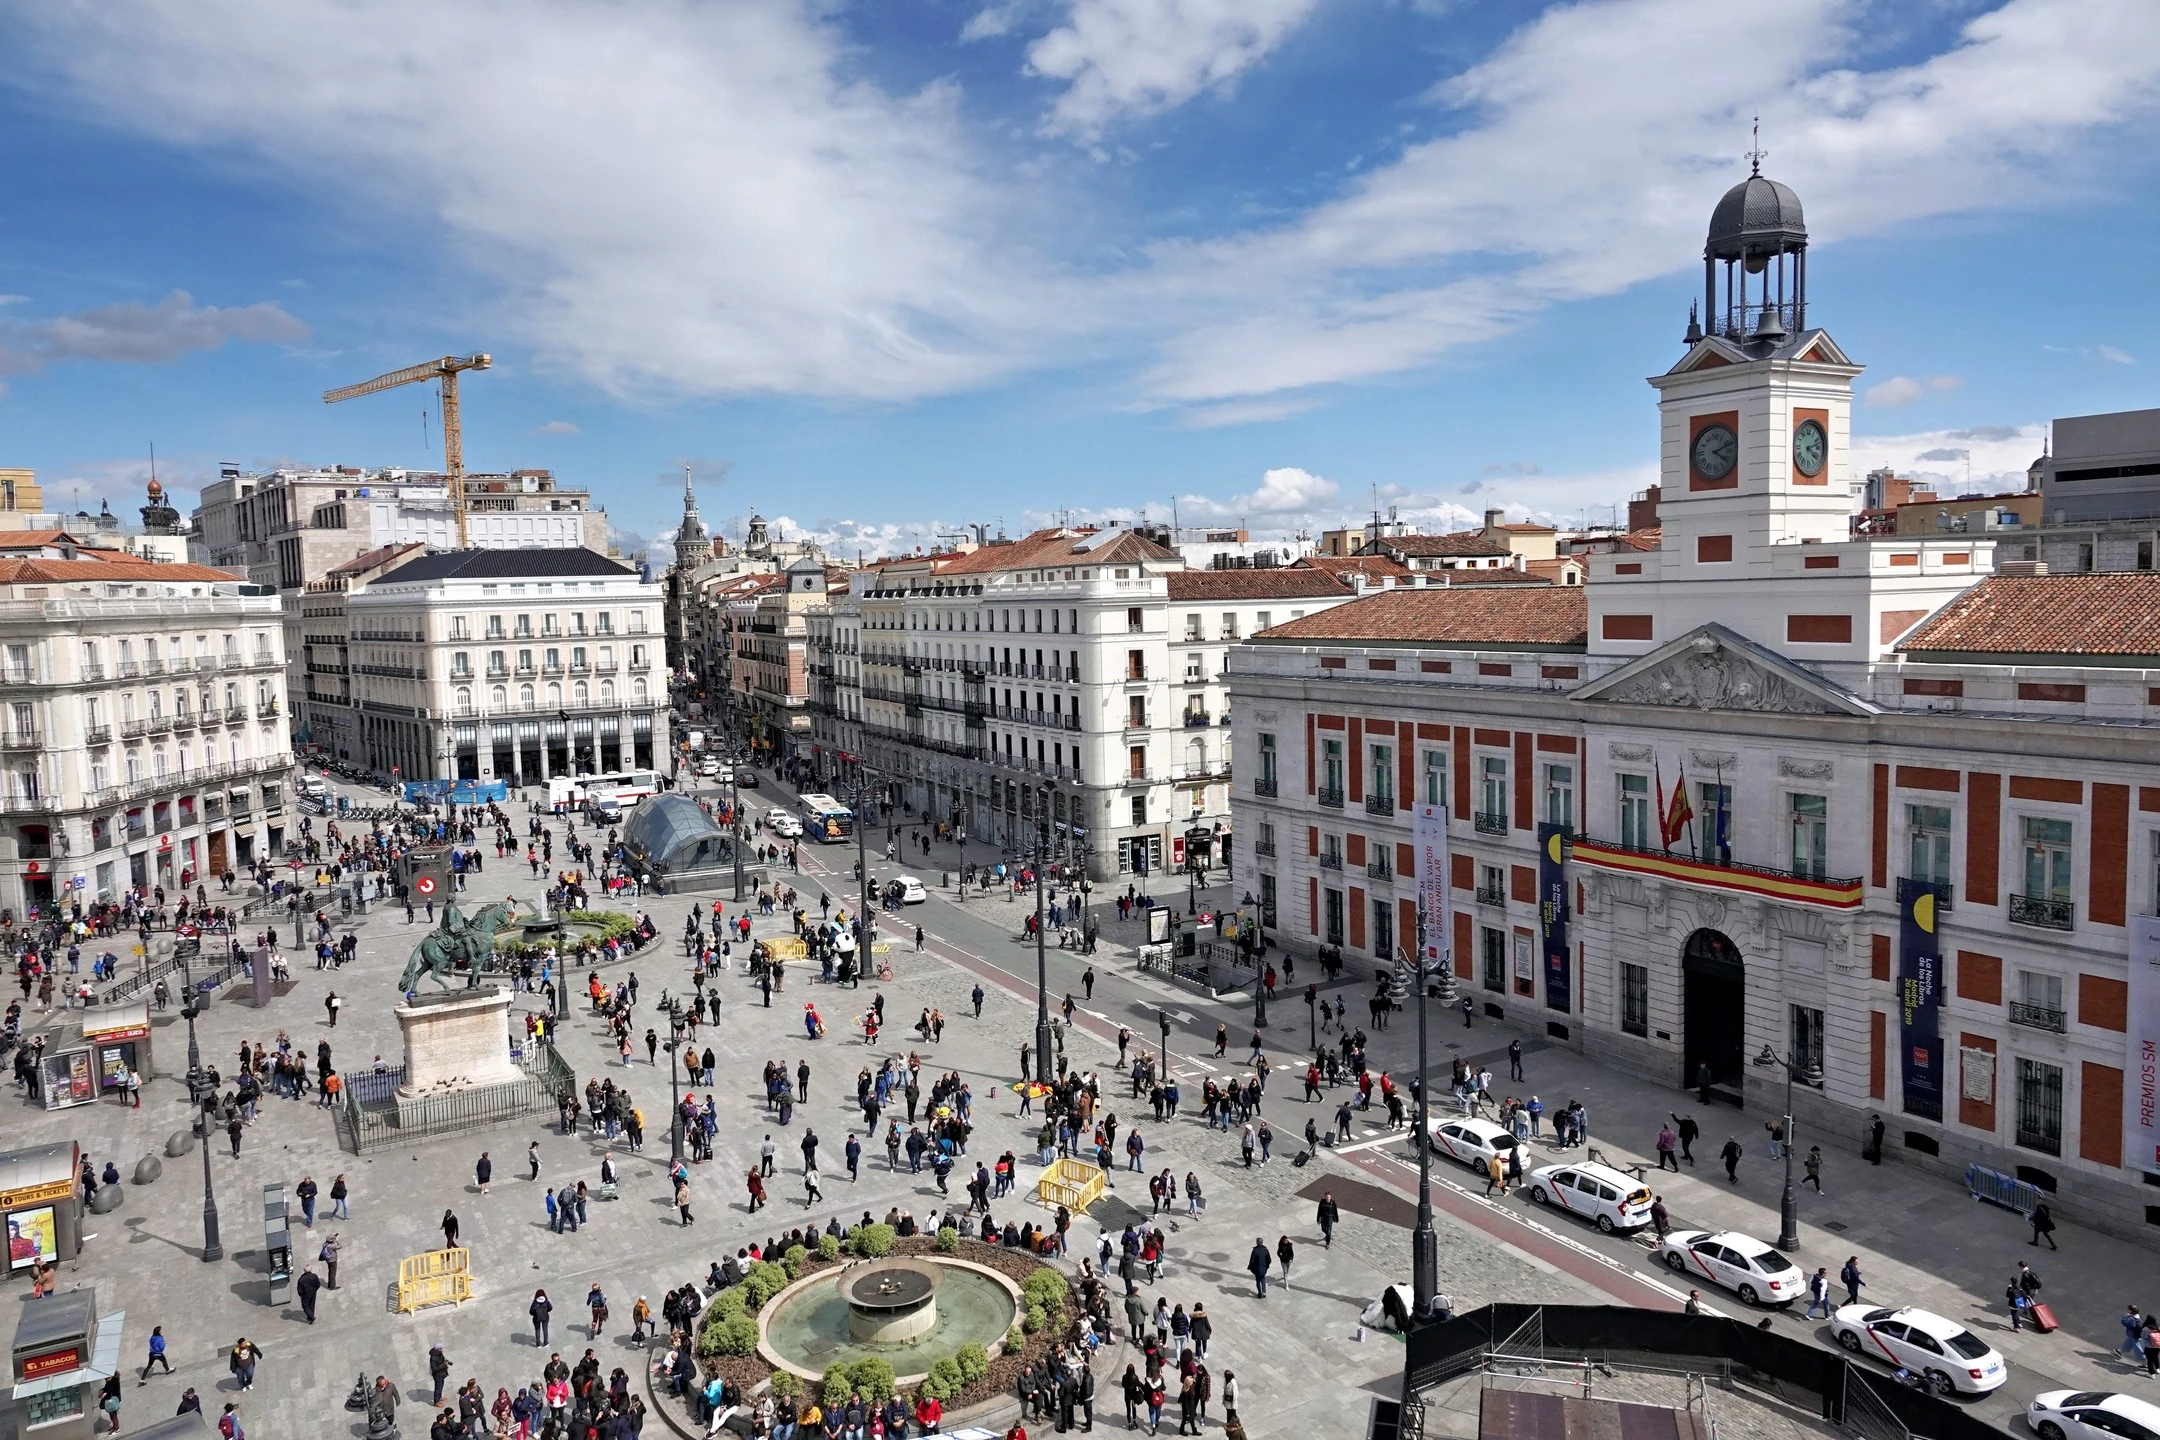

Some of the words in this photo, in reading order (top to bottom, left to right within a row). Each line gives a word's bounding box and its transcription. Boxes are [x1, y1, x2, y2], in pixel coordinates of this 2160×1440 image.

[1427, 877, 1434, 891] DE
[1427, 893, 1435, 924] BARCO
[1429, 926, 1435, 937] EL
[1919, 956, 1925, 967] de
[1926, 958, 1932, 968] La
[1905, 977, 1911, 988] 26
[2142, 1040, 2156, 1062] SM
[2141, 1064, 2155, 1128] PREMIOS
[14, 1193, 35, 1203] TOURS
[43, 1187, 69, 1196] TICKETS
[40, 1354, 76, 1367] TABACOS
